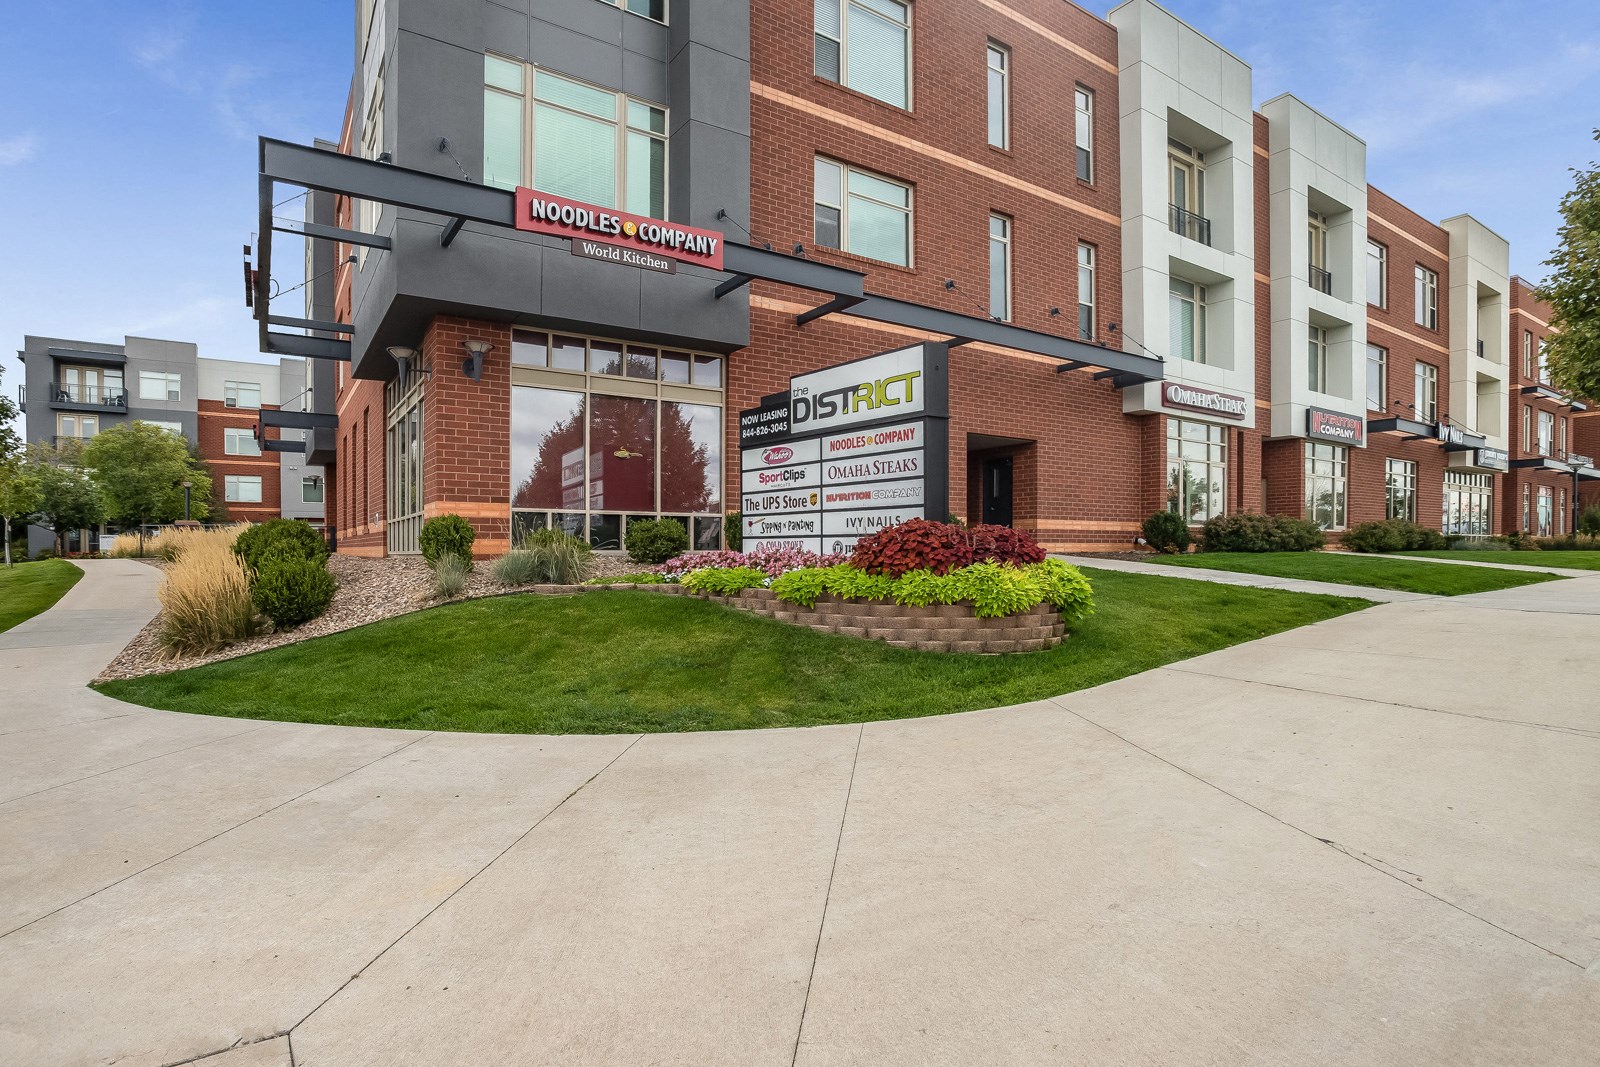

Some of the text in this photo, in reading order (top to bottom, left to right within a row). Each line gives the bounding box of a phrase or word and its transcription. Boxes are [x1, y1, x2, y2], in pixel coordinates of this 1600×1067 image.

[532, 198, 717, 255] NOODLES & COMPANY
[583, 242, 668, 270] World Kitchen
[792, 387, 808, 397] the
[792, 371, 921, 424] DISTRICT
[1167, 385, 1248, 415] OMAHA STEAKS
[742, 408, 788, 425] NOW LEASING
[742, 422, 787, 438] 844-826-3045
[1320, 425, 1354, 438] COMPANY
[829, 436, 866, 452] NOODLES
[874, 428, 915, 445] COMPANY
[828, 458, 918, 479] OMAHA STEAKS
[759, 469, 806, 485] SportClips
[826, 491, 871, 502] NUTRITION
[872, 487, 922, 499] COMPANY
[745, 499, 760, 511] The
[762, 496, 780, 510] UPS
[783, 495, 808, 509] Store
[846, 516, 901, 527] IVY NAILS
